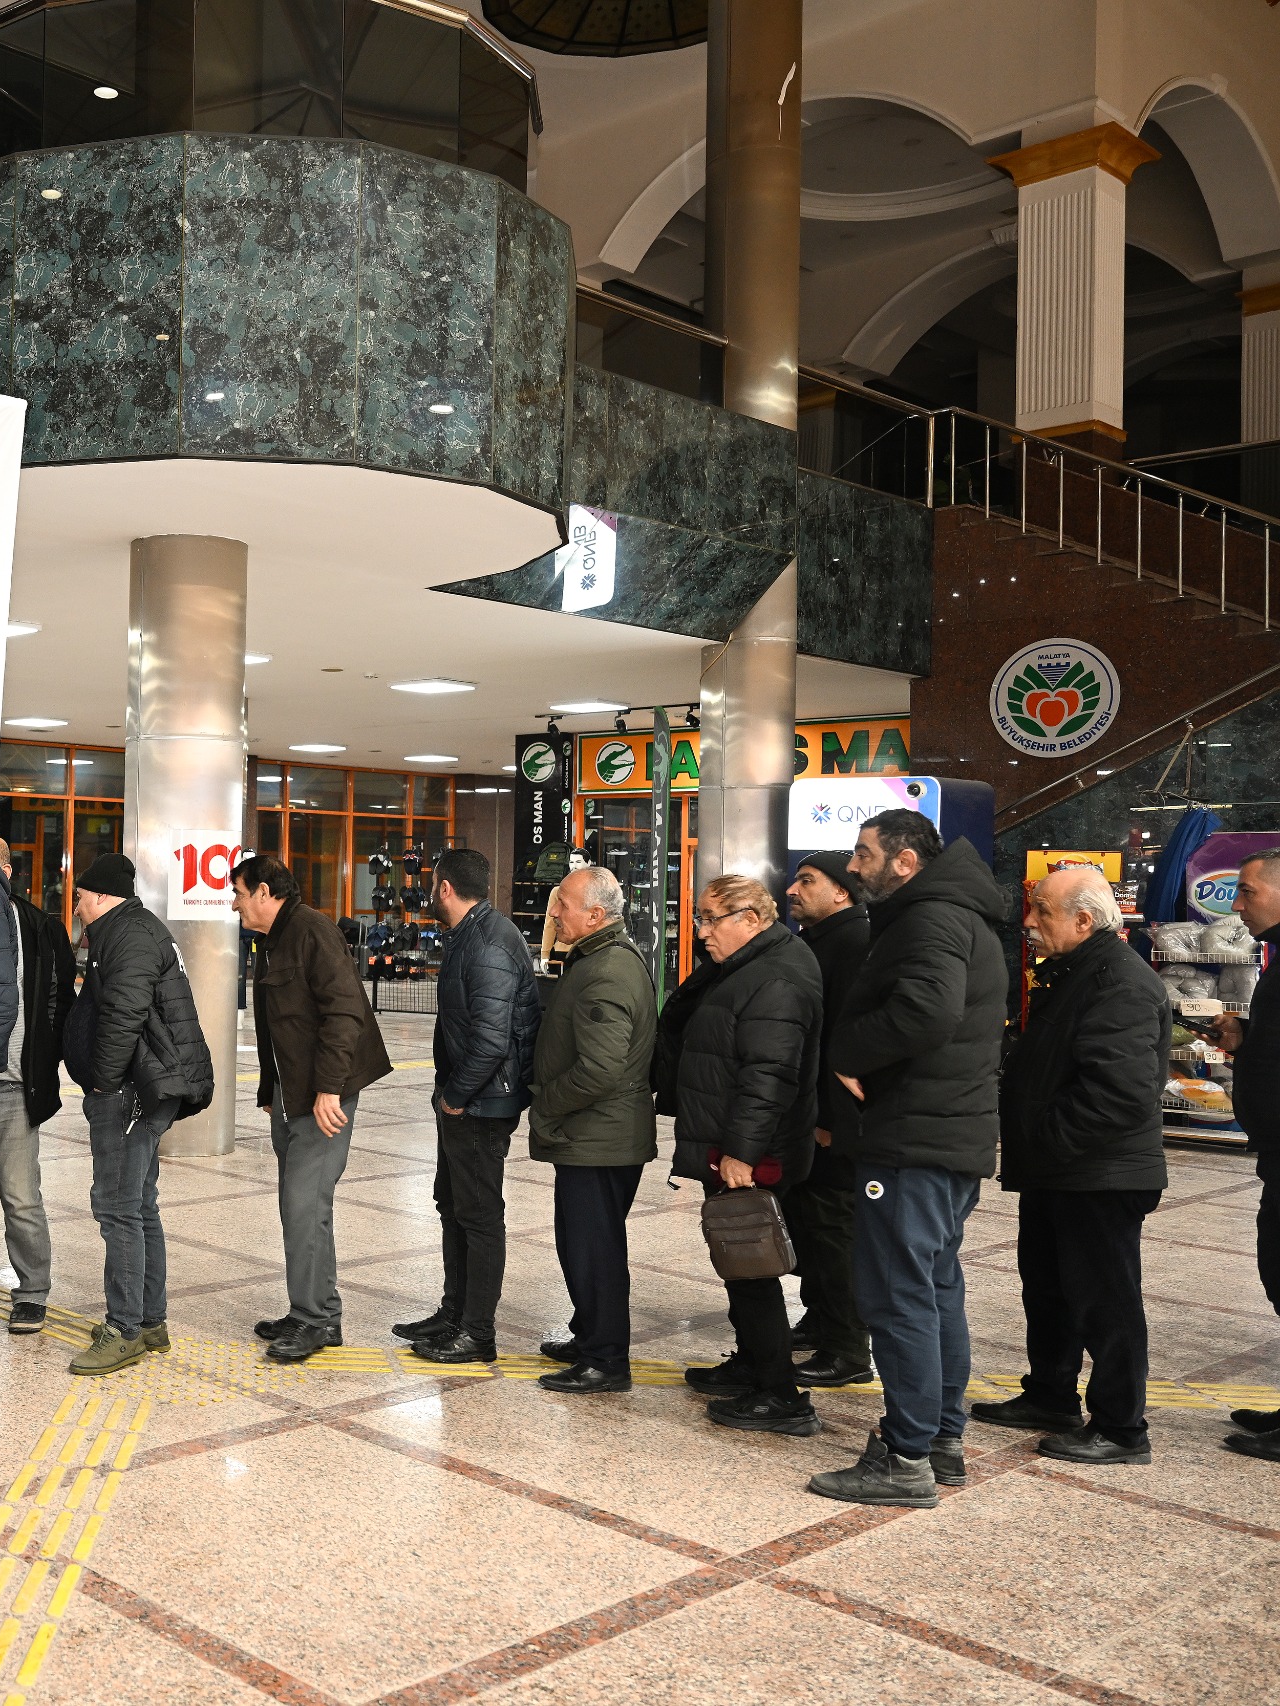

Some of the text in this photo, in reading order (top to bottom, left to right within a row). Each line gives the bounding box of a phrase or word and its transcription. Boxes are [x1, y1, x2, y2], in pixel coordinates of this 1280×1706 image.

[1037, 652, 1071, 660] MALATYA
[998, 711, 1112, 752] BÜYÜKŞEHİR BELEDİYESİ
[821, 728, 910, 774] MA
[533, 791, 543, 823] MAN
[837, 805, 888, 822] QN
[1196, 881, 1239, 901] Dou
